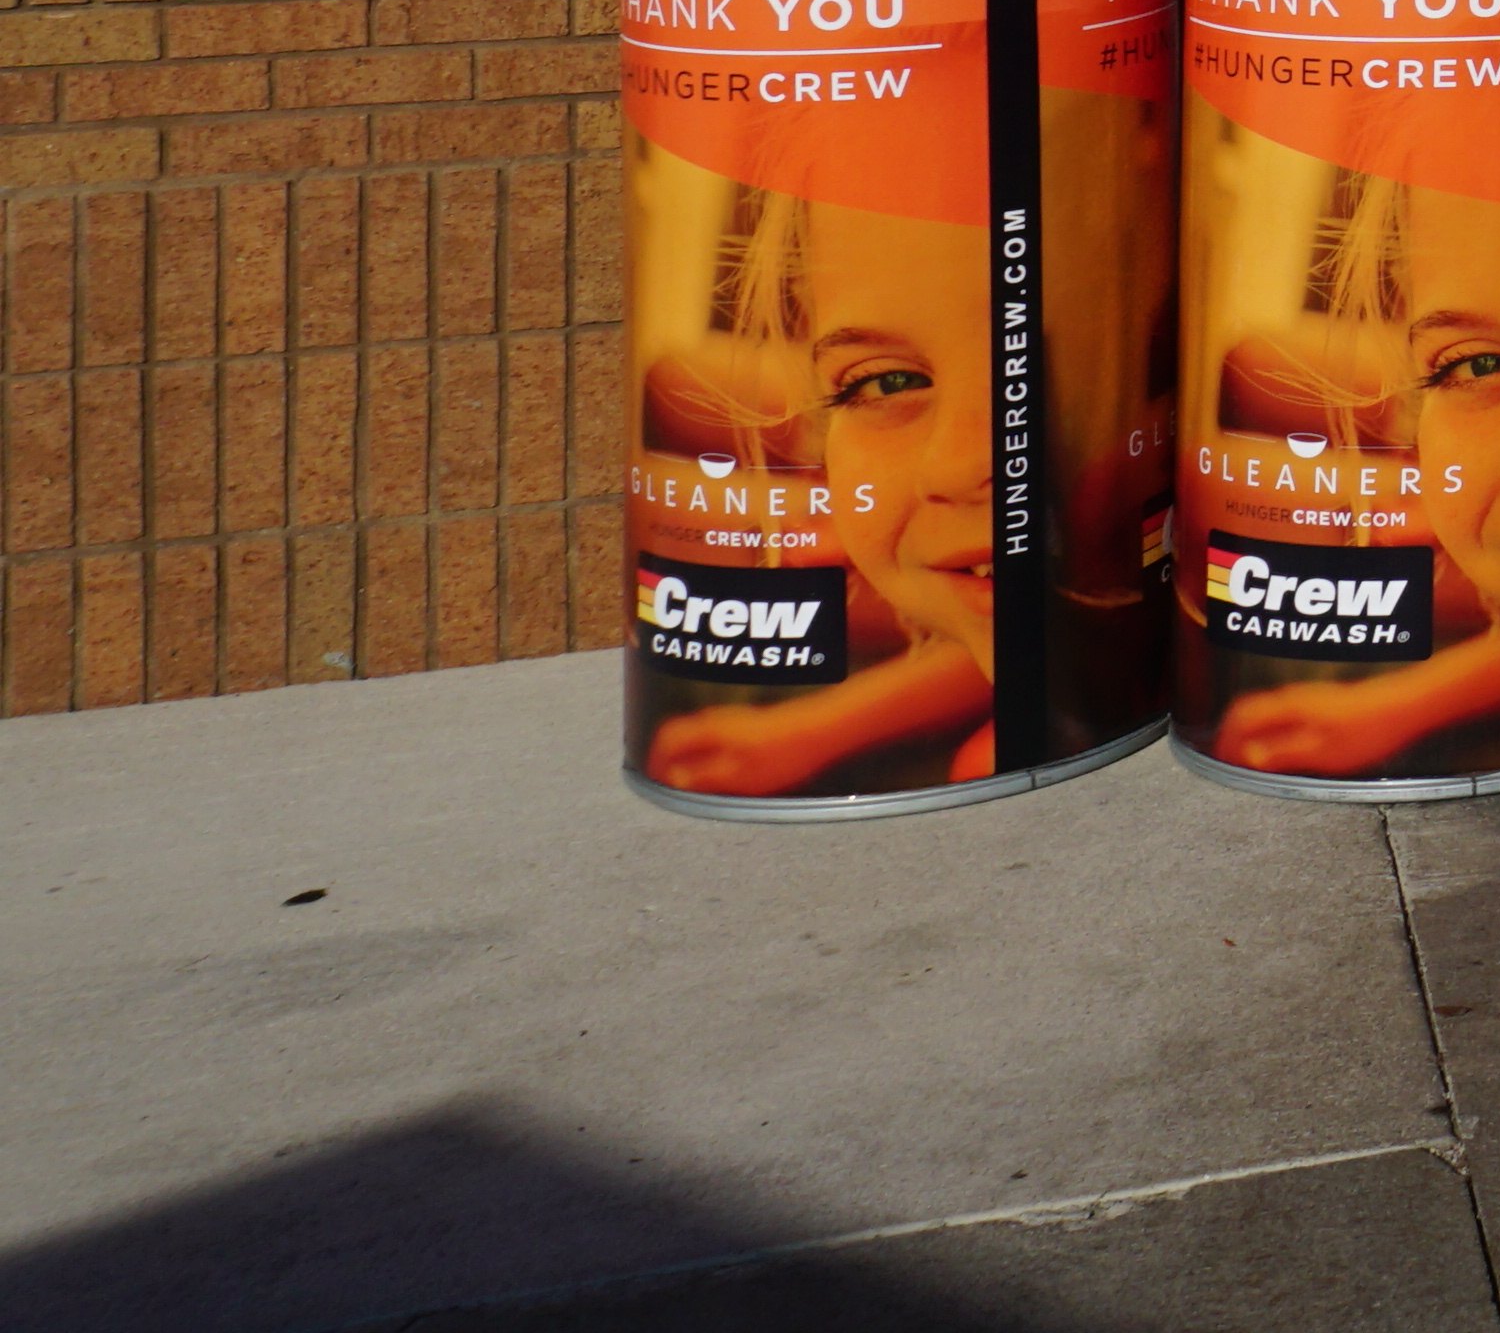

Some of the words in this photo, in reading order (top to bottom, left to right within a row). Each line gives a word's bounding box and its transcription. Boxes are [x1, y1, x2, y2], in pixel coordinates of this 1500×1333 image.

[630, 466, 875, 516] GLEANERS
[1199, 447, 1462, 495] GLEANERS
[1225, 499, 1406, 528] HUNGERCREW.COM
[653, 576, 821, 638] Crew
[1228, 555, 1408, 617] Crew
